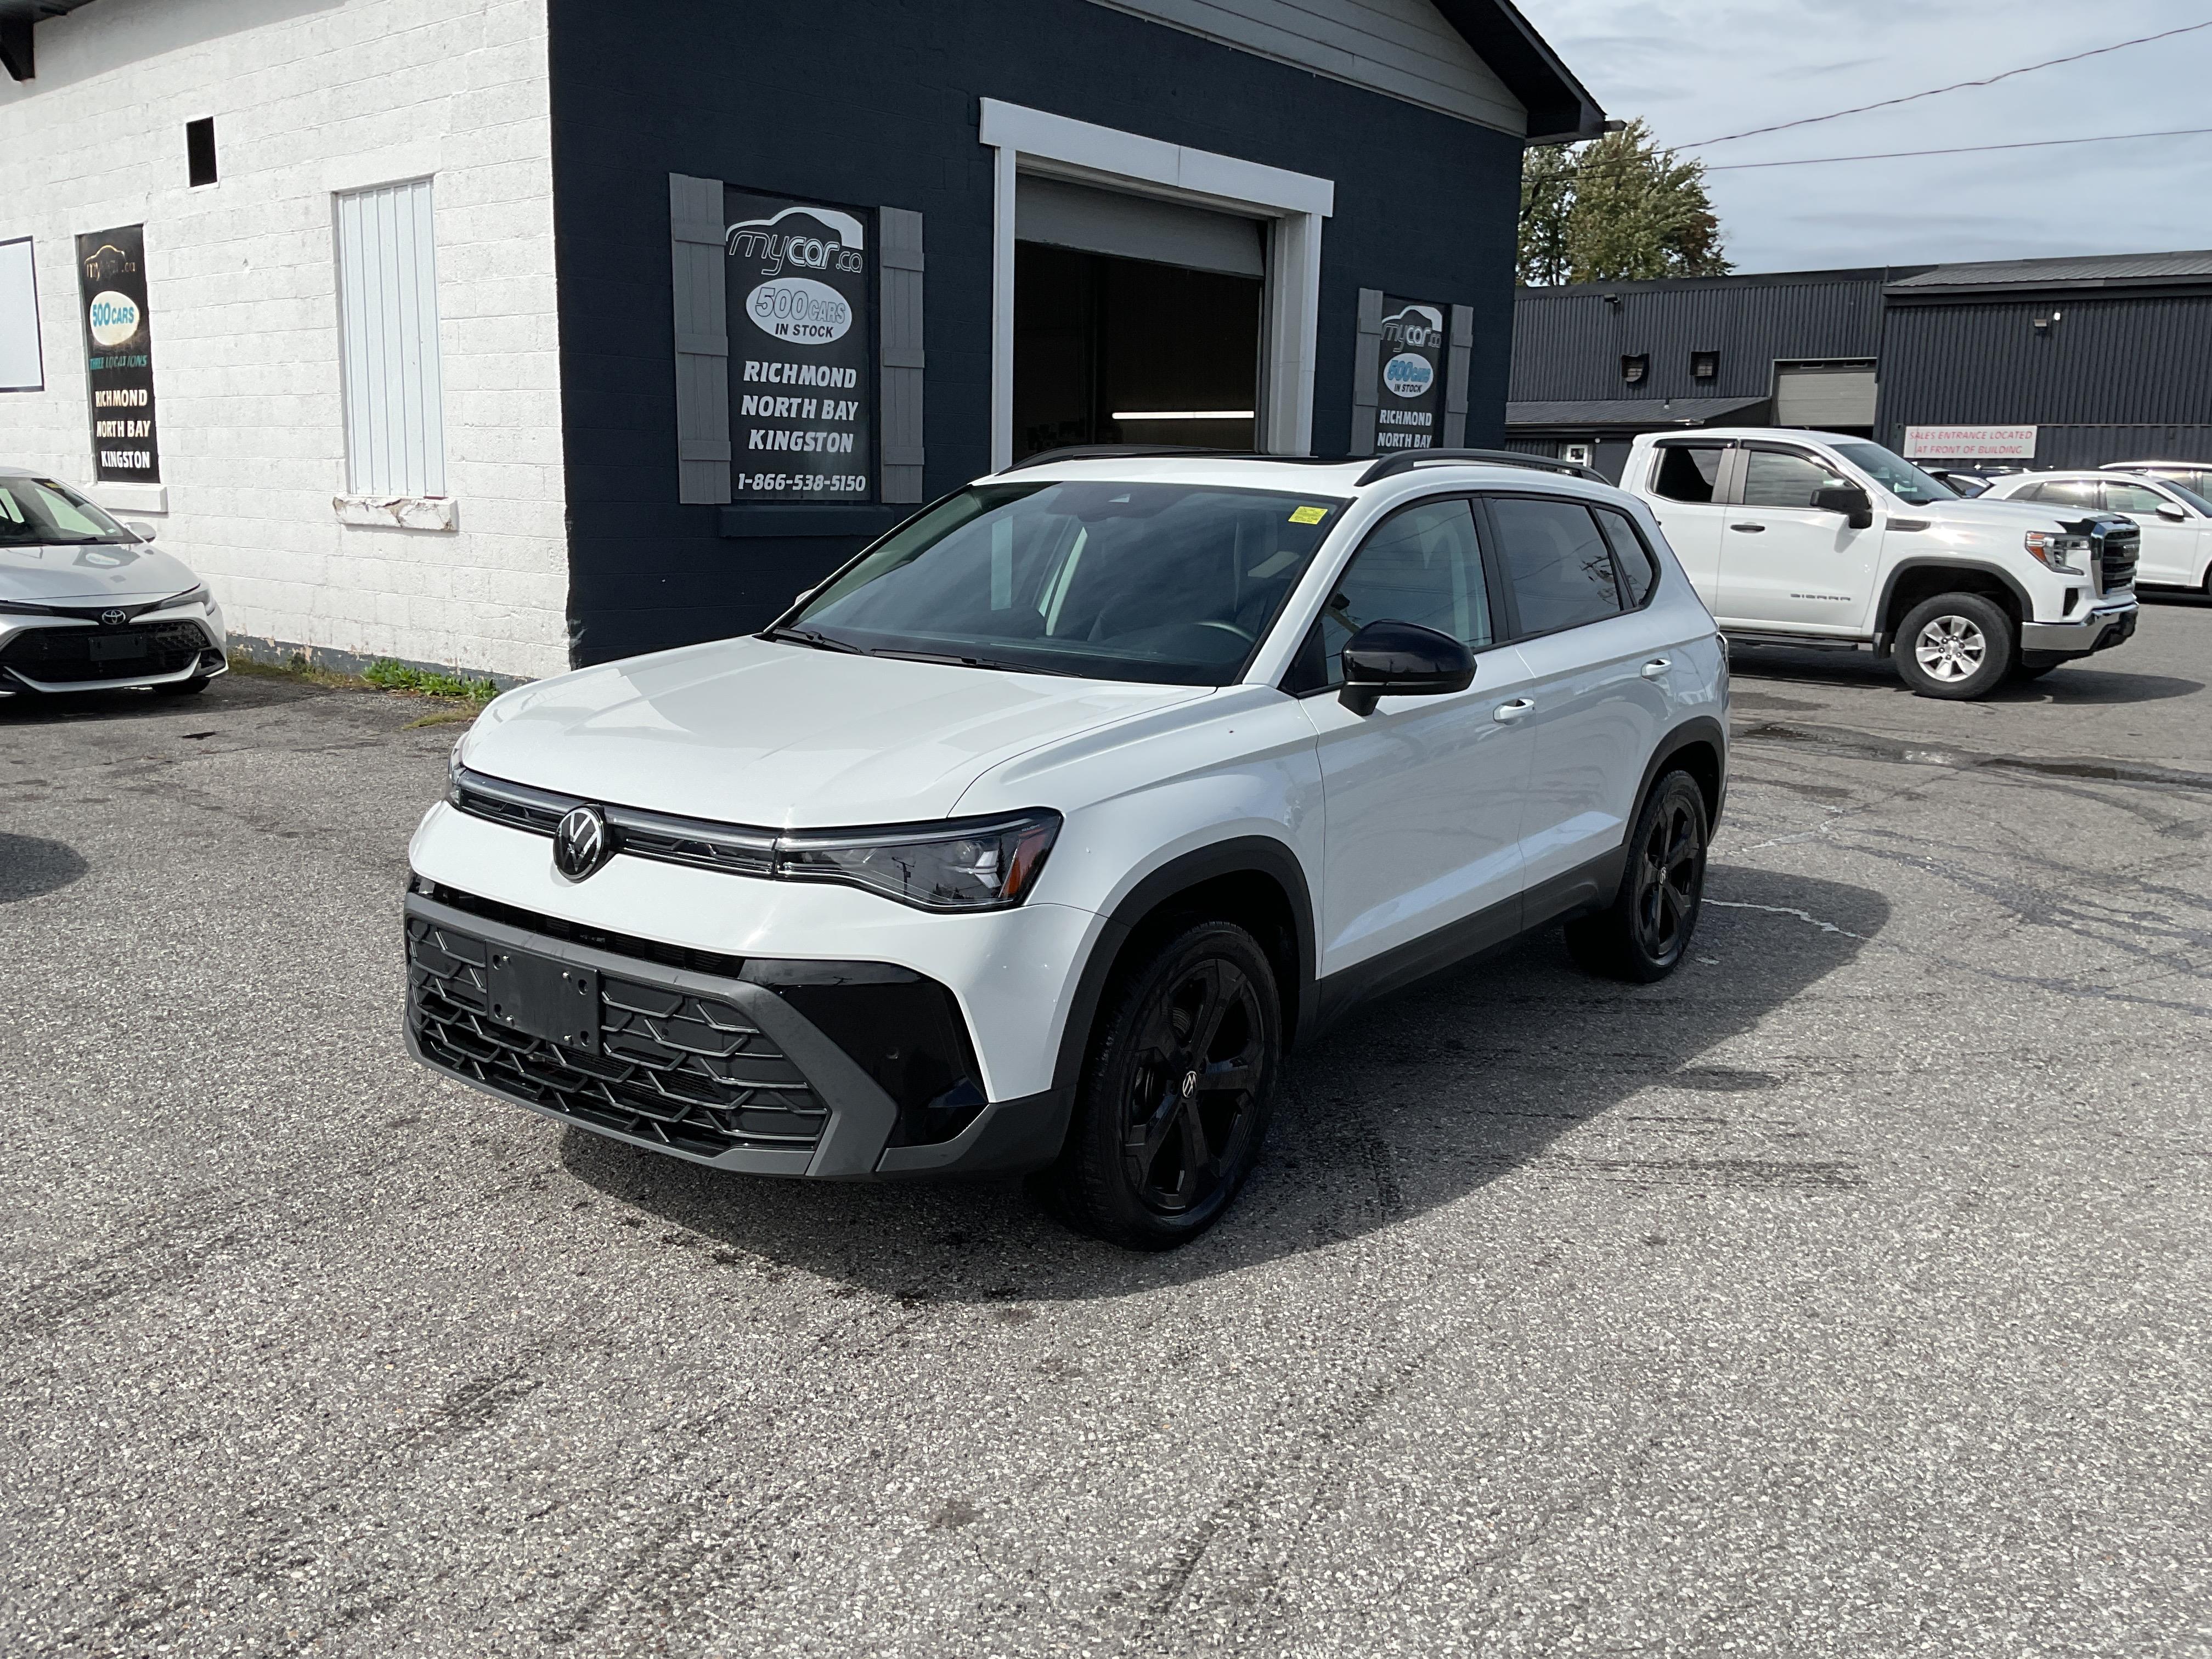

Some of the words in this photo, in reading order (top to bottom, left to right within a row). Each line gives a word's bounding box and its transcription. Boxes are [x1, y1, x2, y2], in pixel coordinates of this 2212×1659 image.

[111, 307, 134, 324] CARS
[775, 323, 788, 336] IN
[792, 325, 833, 338] STOCK
[743, 361, 856, 388] RICHMOND
[1402, 385, 1423, 393] STOCK
[95, 389, 148, 407] RICHMOND
[741, 395, 817, 419] NORTH
[822, 400, 859, 421] BAY
[1379, 410, 1432, 426] RICHMOND
[97, 421, 124, 437] NORTH
[127, 420, 151, 437] BAY
[1938, 431, 1987, 439] ENTRANCE
[1990, 431, 2033, 439] LOCATED
[748, 430, 854, 453] KINGSTON
[1377, 432, 1412, 447] NORTH
[1414, 435, 1432, 448] BAY
[100, 451, 150, 469] KINGSTON
[738, 473, 866, 492] 1-866-538-5150
